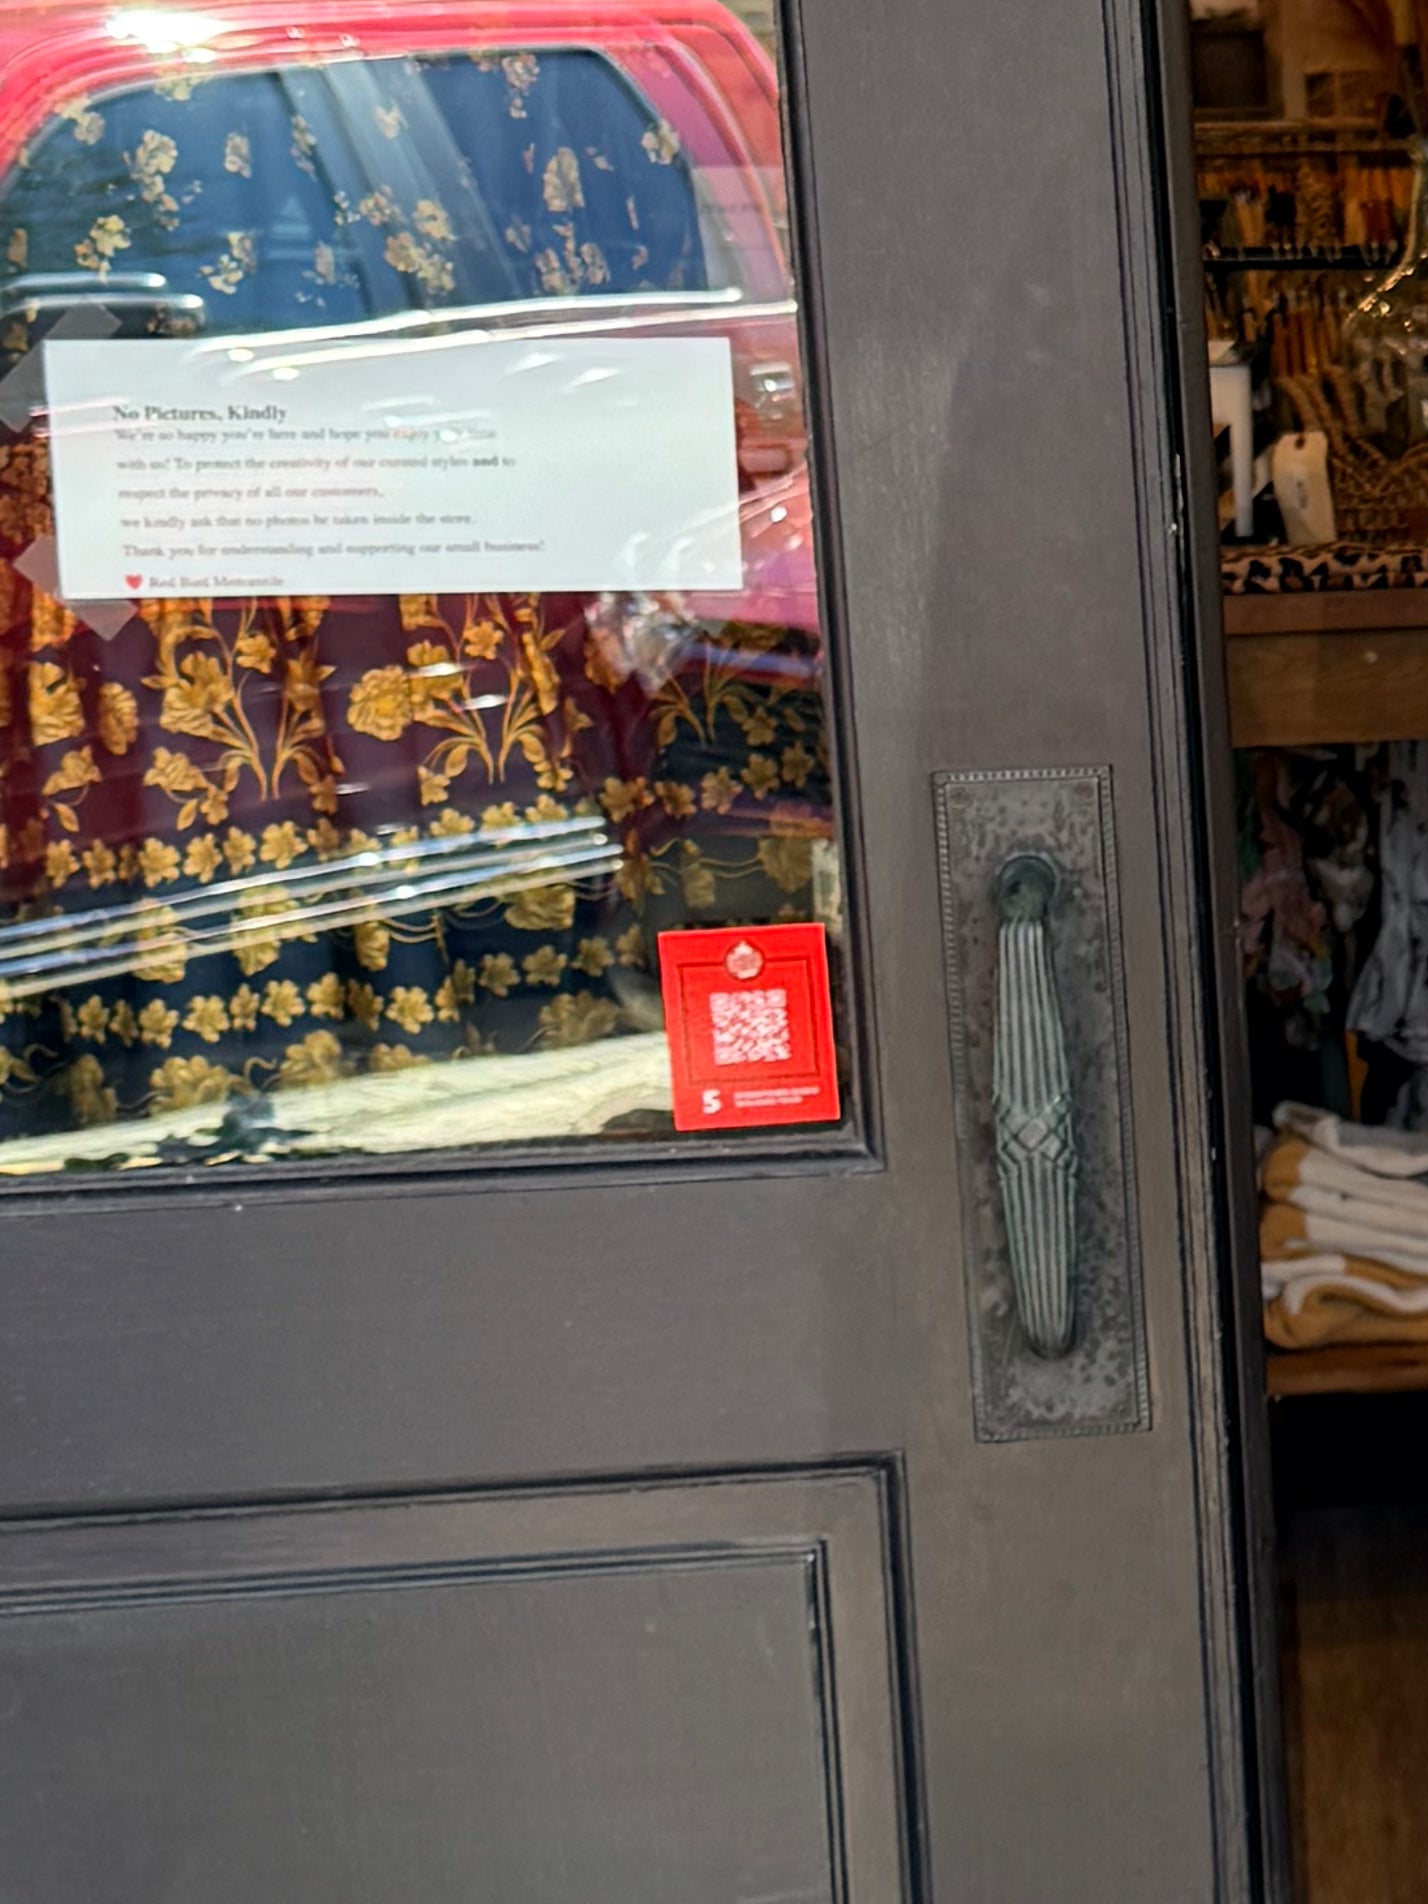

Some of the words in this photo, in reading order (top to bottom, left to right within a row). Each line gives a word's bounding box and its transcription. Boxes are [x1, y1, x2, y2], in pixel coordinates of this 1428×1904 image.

[112, 404, 140, 421] No
[144, 404, 223, 422] Pictures,
[228, 404, 288, 424] Kindly
[177, 428, 217, 443] happy
[222, 428, 264, 443] you're
[301, 428, 325, 440] and
[329, 428, 361, 442] hope
[365, 430, 390, 443] you
[116, 457, 146, 470] with
[174, 457, 192, 470] To
[244, 457, 266, 470] the
[335, 456, 350, 467] of
[473, 455, 499, 467] and
[502, 457, 517, 467] to
[169, 486, 190, 498] the
[194, 488, 242, 501] privacy
[246, 486, 261, 498] of
[265, 485, 281, 497] all
[120, 518, 140, 528] we
[190, 516, 212, 527] ask
[216, 515, 241, 527] that
[415, 511, 436, 525] the
[122, 543, 165, 557] Thank
[169, 547, 194, 560] you
[198, 543, 218, 556] for
[221, 542, 314, 558] understanding
[318, 542, 343, 555] and
[445, 539, 480, 553] small
